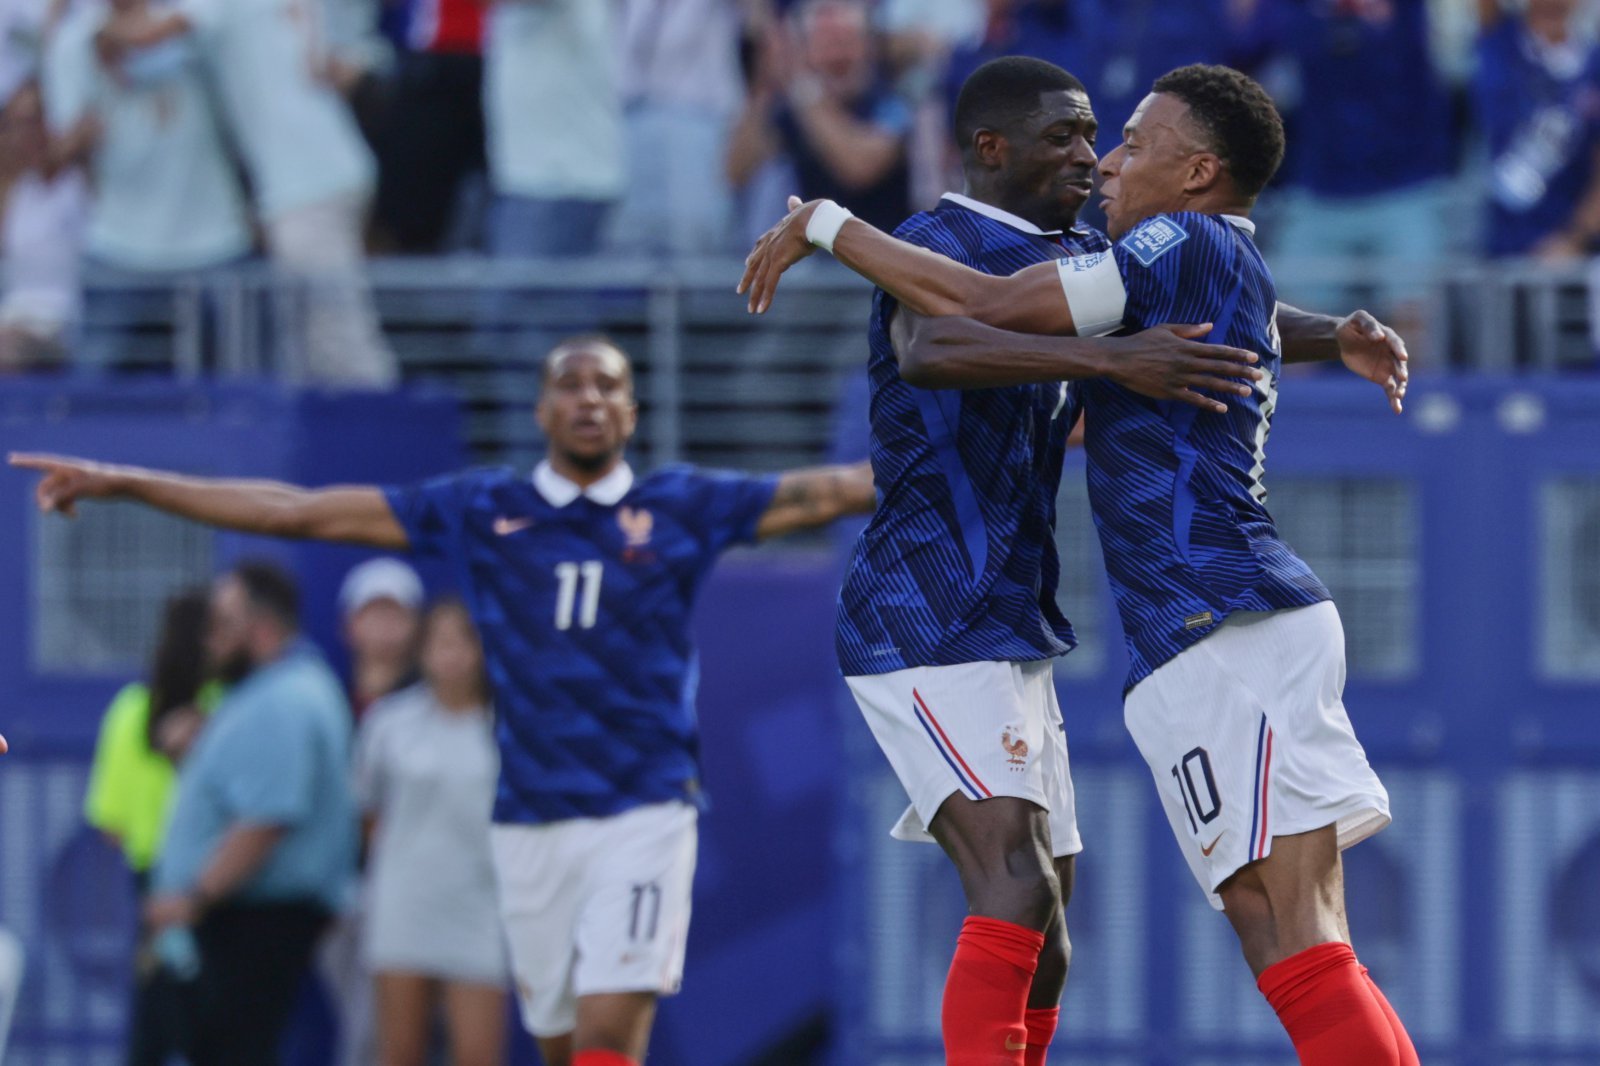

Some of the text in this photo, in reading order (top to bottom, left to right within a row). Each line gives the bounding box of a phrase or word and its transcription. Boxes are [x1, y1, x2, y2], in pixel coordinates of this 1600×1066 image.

[554, 560, 604, 631] 11
[1171, 746, 1222, 835] 10
[628, 882, 661, 941] 11
